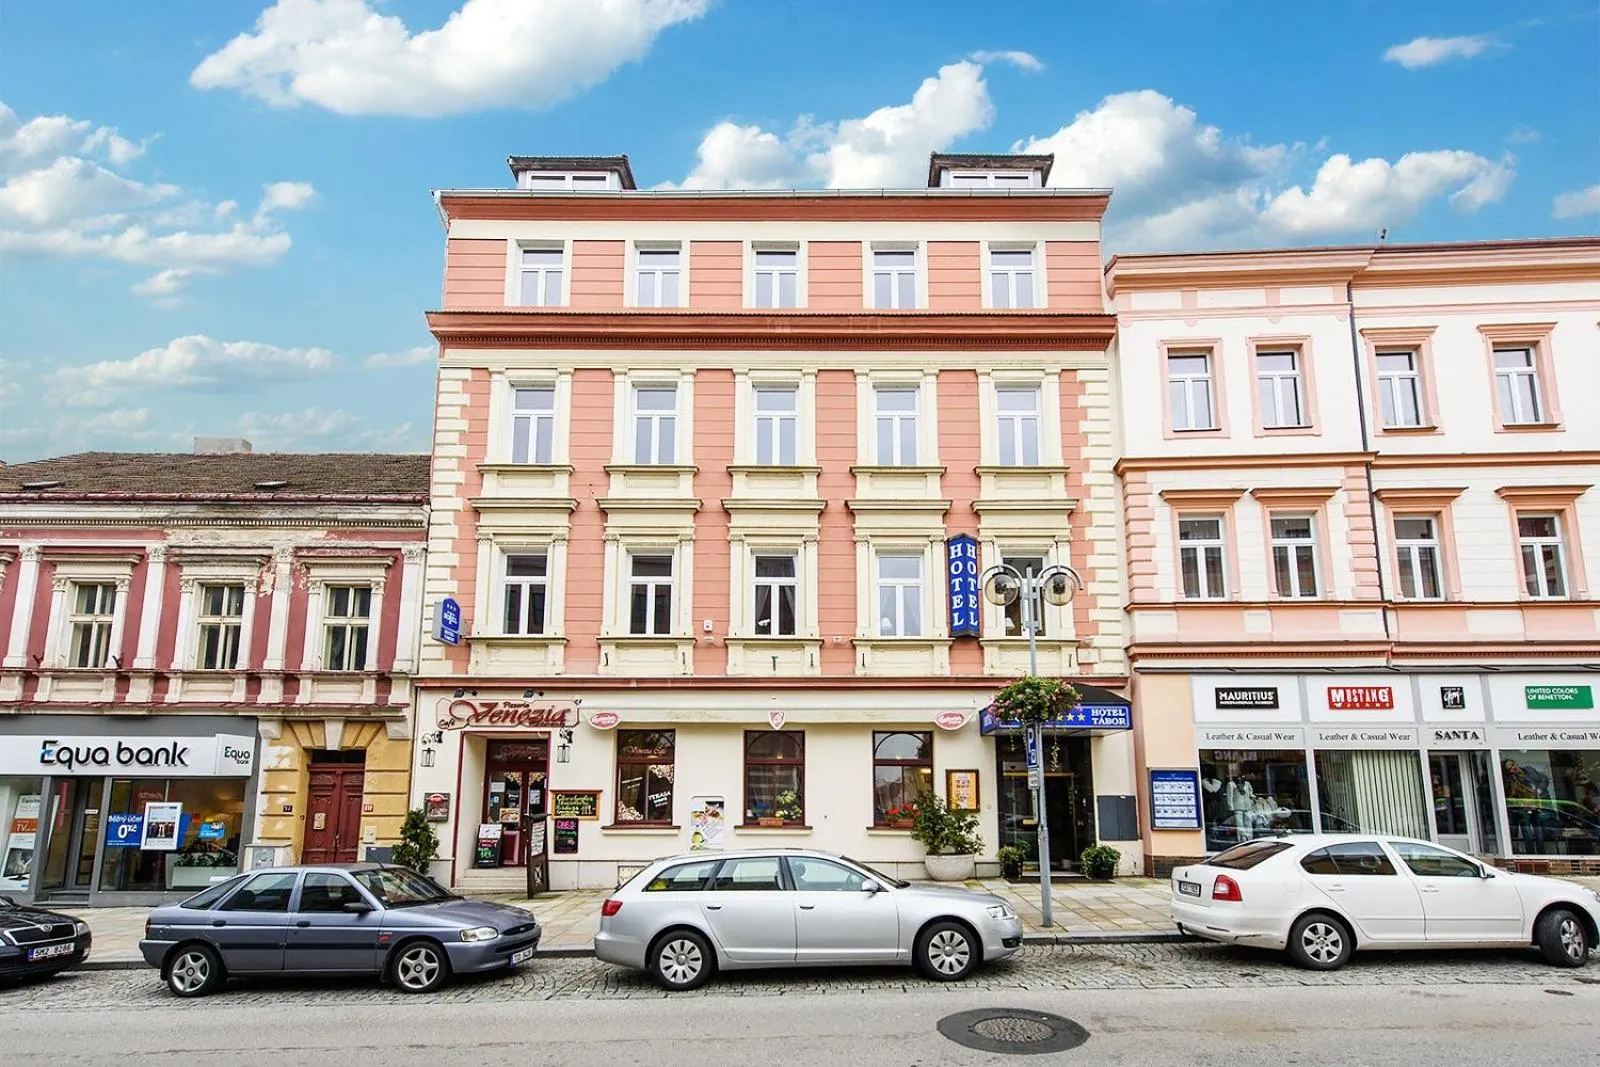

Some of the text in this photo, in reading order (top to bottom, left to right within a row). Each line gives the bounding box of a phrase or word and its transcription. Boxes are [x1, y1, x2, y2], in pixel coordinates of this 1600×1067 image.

[949, 542, 964, 626] HOTEL
[966, 543, 978, 626] HOTEL
[1218, 691, 1274, 701] MAURITIUS
[1330, 688, 1390, 703] MUSTANG
[503, 701, 529, 709] Pizzeria
[449, 699, 571, 724] Venezia
[1091, 709, 1126, 717] HOTEL
[1205, 732, 1295, 741] Leather & Casual Wear
[1319, 732, 1411, 741] Leather & Casual Wear
[1434, 730, 1480, 741] SANTA
[1517, 732, 1600, 741] Leather & Casual W
[40, 739, 189, 773] Equa bank
[224, 746, 250, 763] Equa
